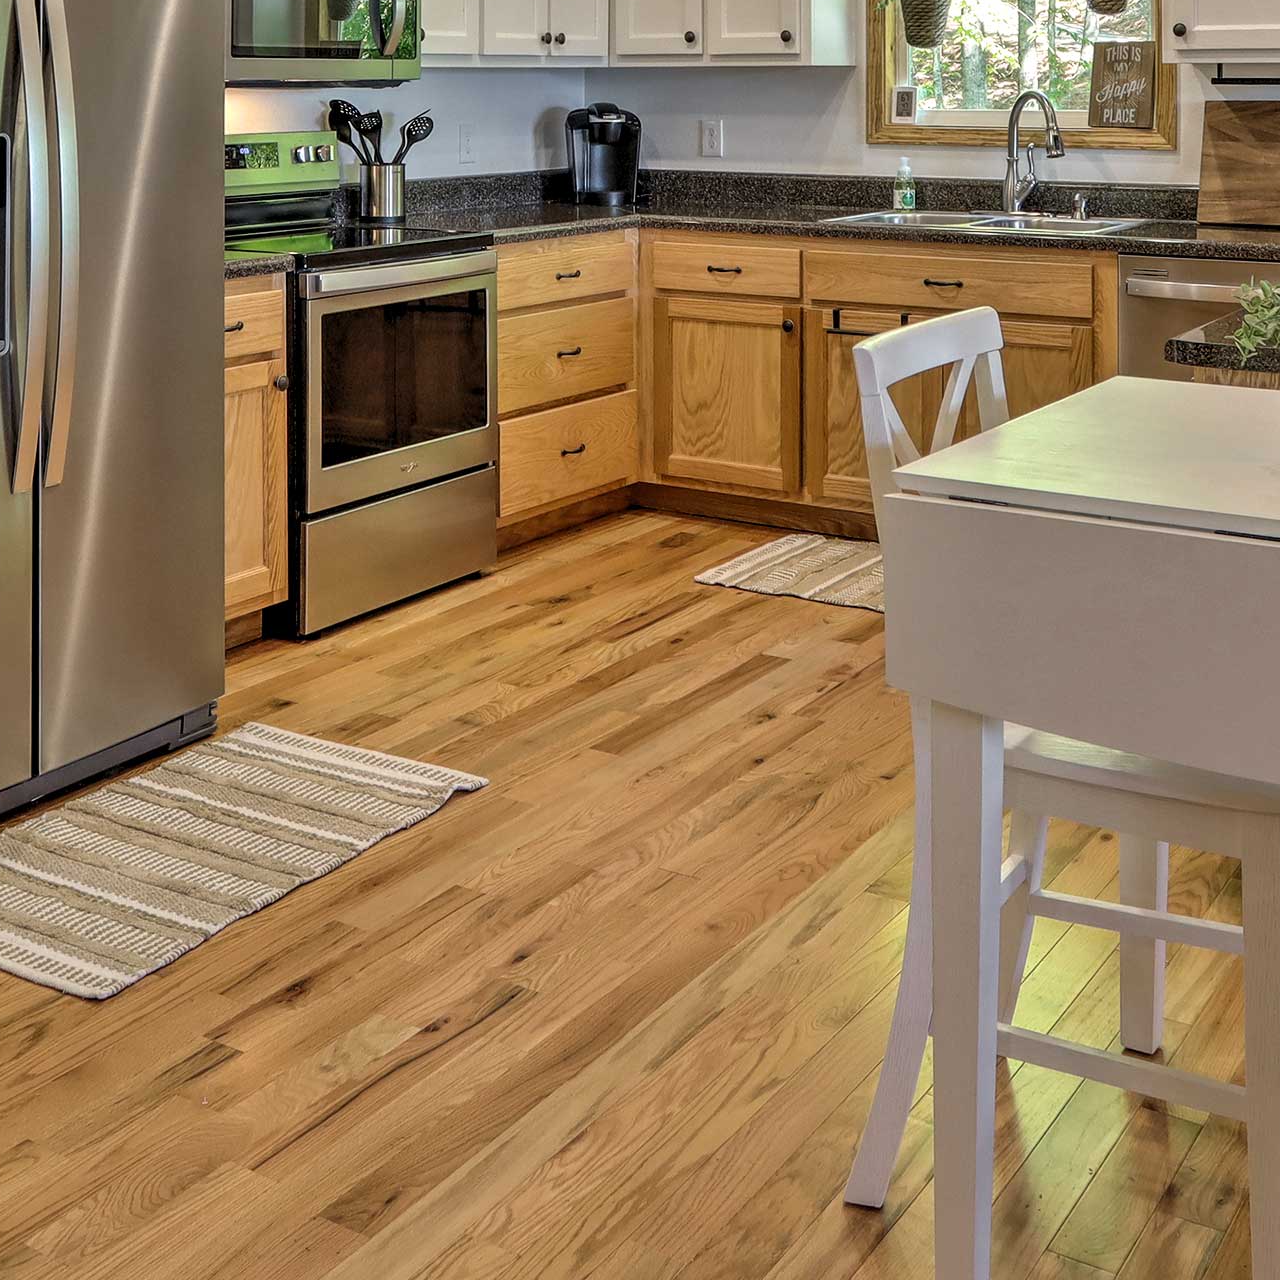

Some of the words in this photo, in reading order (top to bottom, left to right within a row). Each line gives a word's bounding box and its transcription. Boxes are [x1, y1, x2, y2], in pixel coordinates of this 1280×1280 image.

[1106, 46, 1129, 62] THIS
[1131, 46, 1141, 62] IS
[1114, 62, 1131, 72] MY
[1095, 77, 1147, 103] Happy
[1103, 108, 1136, 123] PLACE
